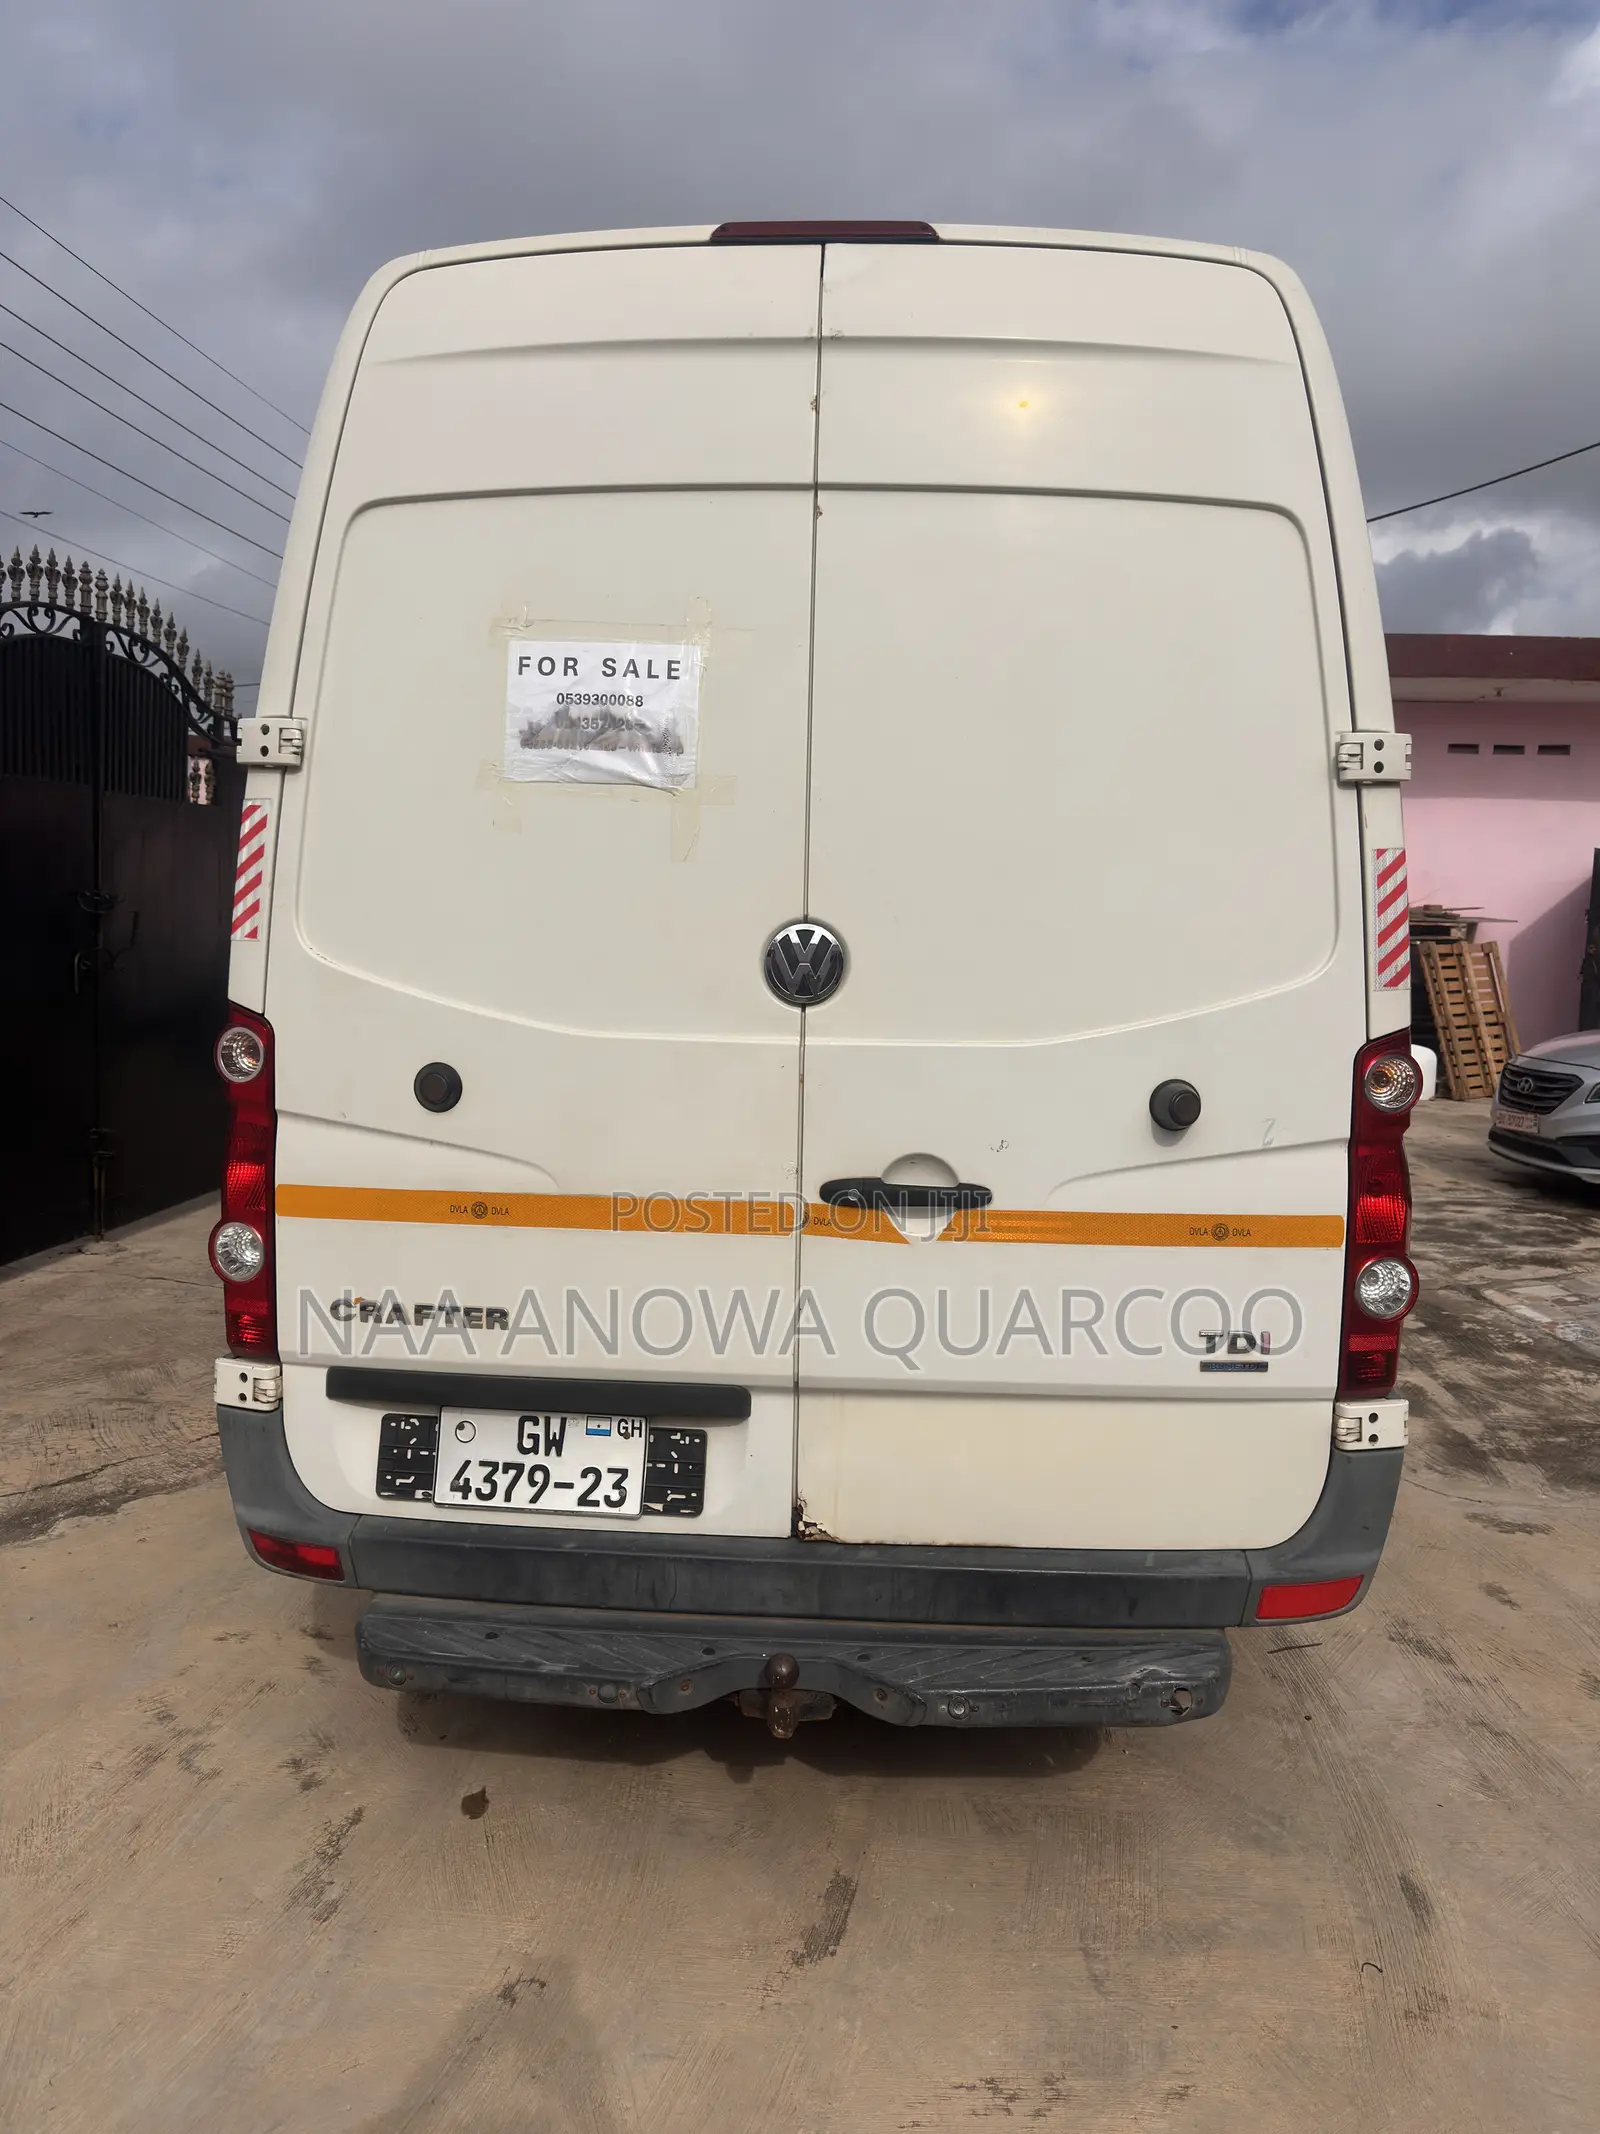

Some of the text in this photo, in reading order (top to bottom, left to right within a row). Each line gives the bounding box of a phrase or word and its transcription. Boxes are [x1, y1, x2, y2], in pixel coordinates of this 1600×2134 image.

[517, 656, 682, 680] FOR SALE
[556, 692, 644, 708] 0539300088
[449, 1204, 469, 1214] DVLA
[491, 1206, 510, 1216] DVLA
[1188, 1226, 1252, 1237] DVLA DVLA
[329, 1297, 510, 1331] CRAFTER
[1198, 1329, 1271, 1355] TDI
[517, 1415, 568, 1458] GW
[616, 1418, 643, 1439] GH
[449, 1460, 630, 1508] 4379-23
